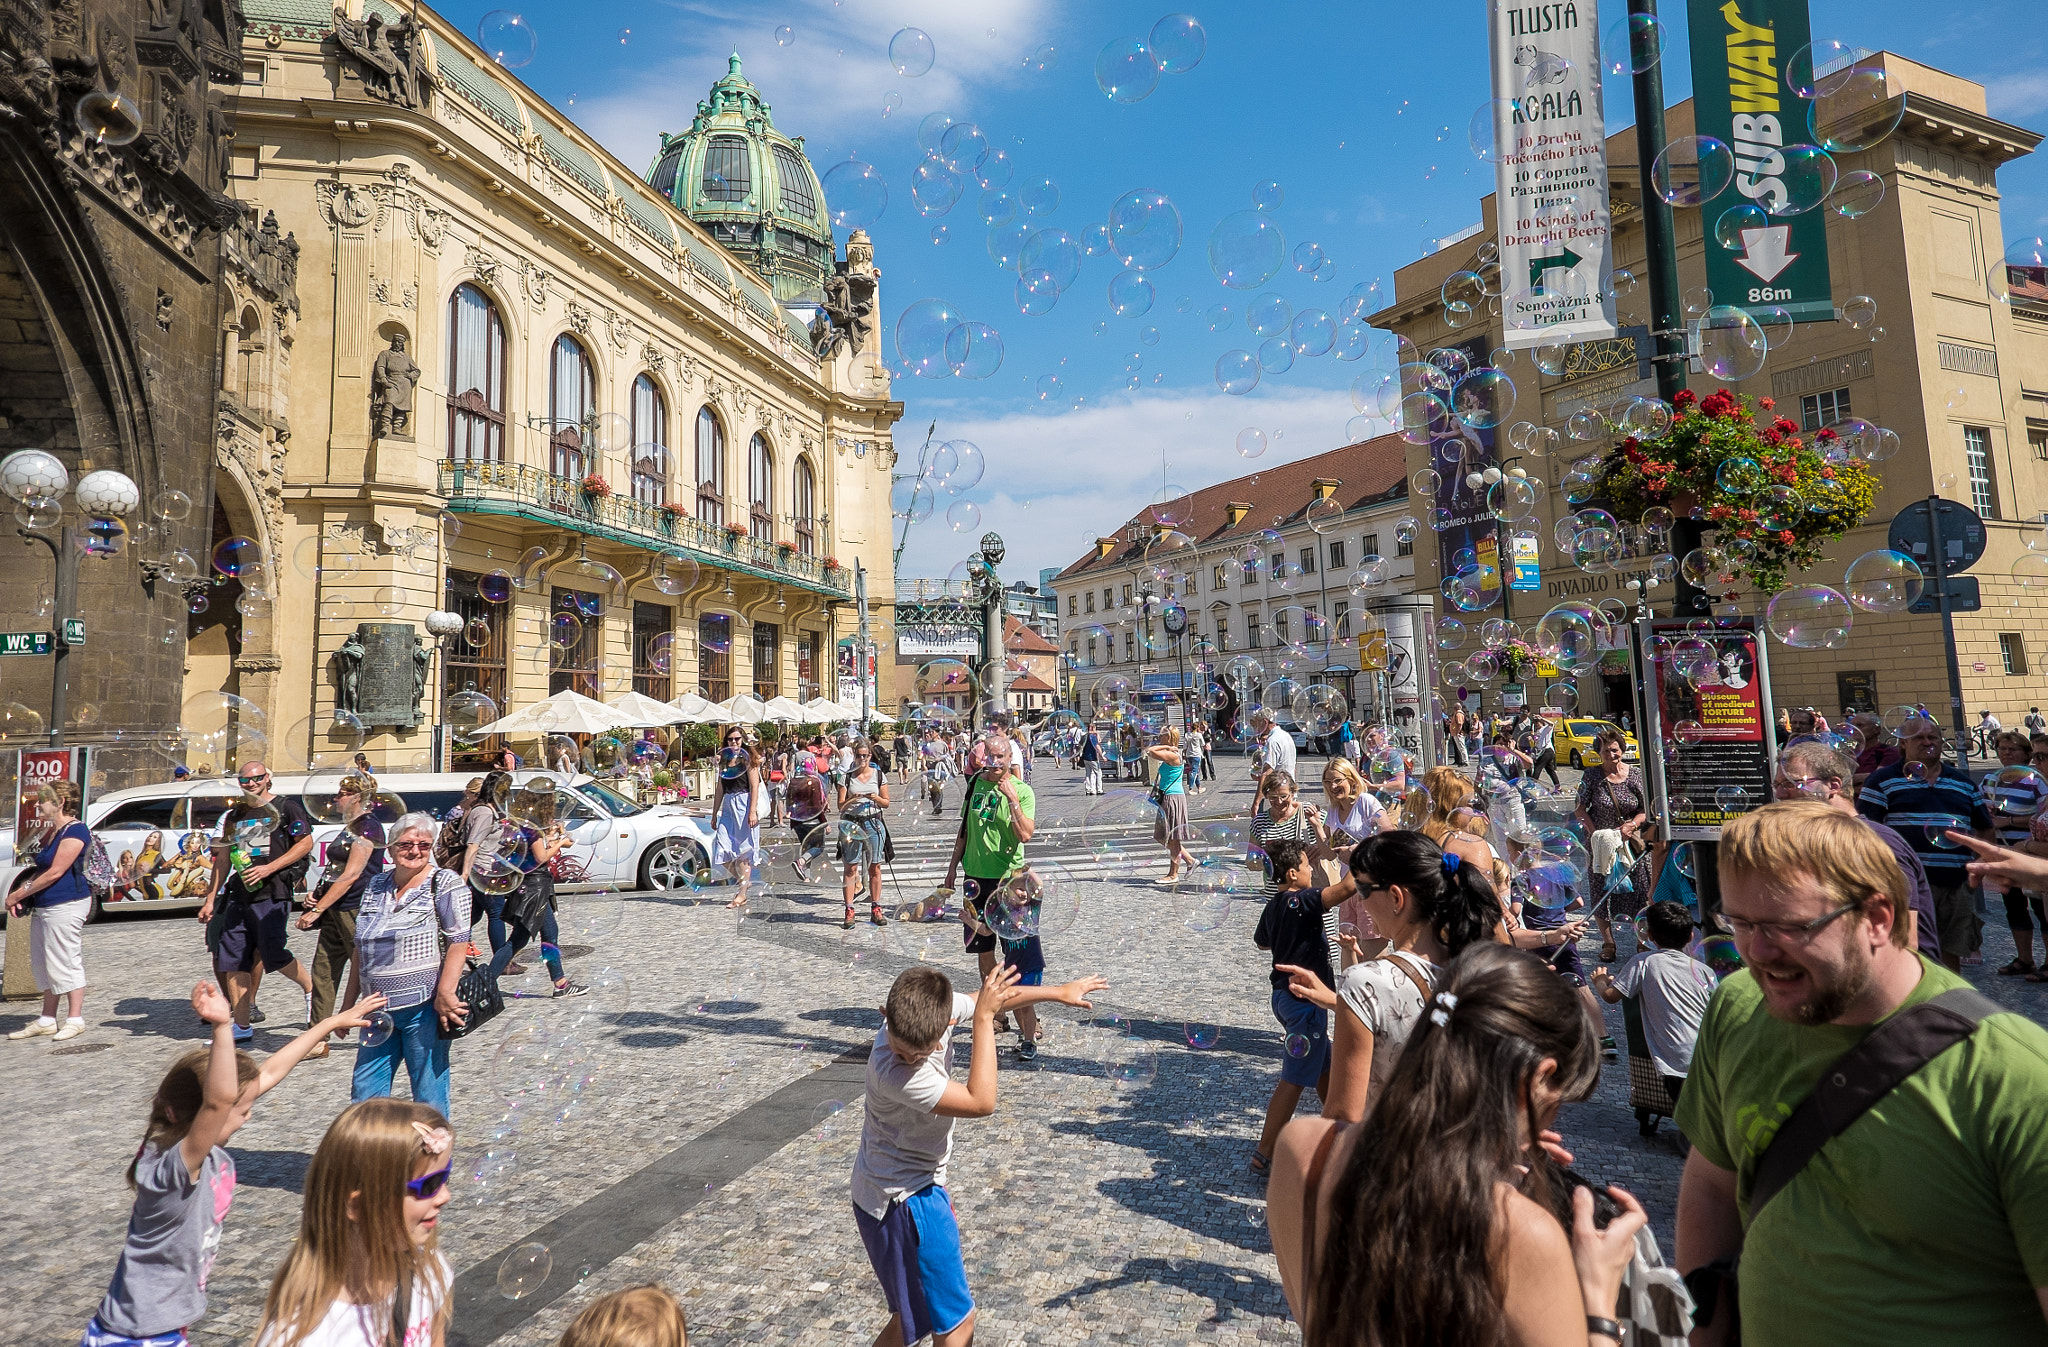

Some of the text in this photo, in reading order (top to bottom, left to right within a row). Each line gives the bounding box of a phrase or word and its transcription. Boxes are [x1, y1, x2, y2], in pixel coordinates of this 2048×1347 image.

[1511, 89, 1582, 124] KOALA
[1719, 0, 1791, 215] SUBWAY
[1518, 129, 1581, 149] 10 Druhů
[1503, 144, 1599, 165] Točeného Piva
[1515, 165, 1589, 183] 10 Сортов
[1510, 178, 1595, 197] Разливного
[1534, 196, 1574, 209] Пива
[1516, 209, 1596, 231] 10 Kinds of
[1505, 225, 1607, 247] Draught Beers
[1516, 292, 1604, 313] Senovážná 8
[1748, 287, 1792, 303] 86m
[1533, 308, 1588, 325] Praha 1
[1439, 516, 1467, 529] ROMEO
[1548, 574, 1608, 598] DIVADLO
[7, 634, 30, 650] WC
[904, 629, 975, 643] ANDERLE
[1702, 693, 1740, 701] Museum
[1714, 700, 1755, 708] medieval
[1703, 708, 1745, 716] TORTURE
[25, 760, 62, 776] 200
[25, 819, 41, 828] 170
